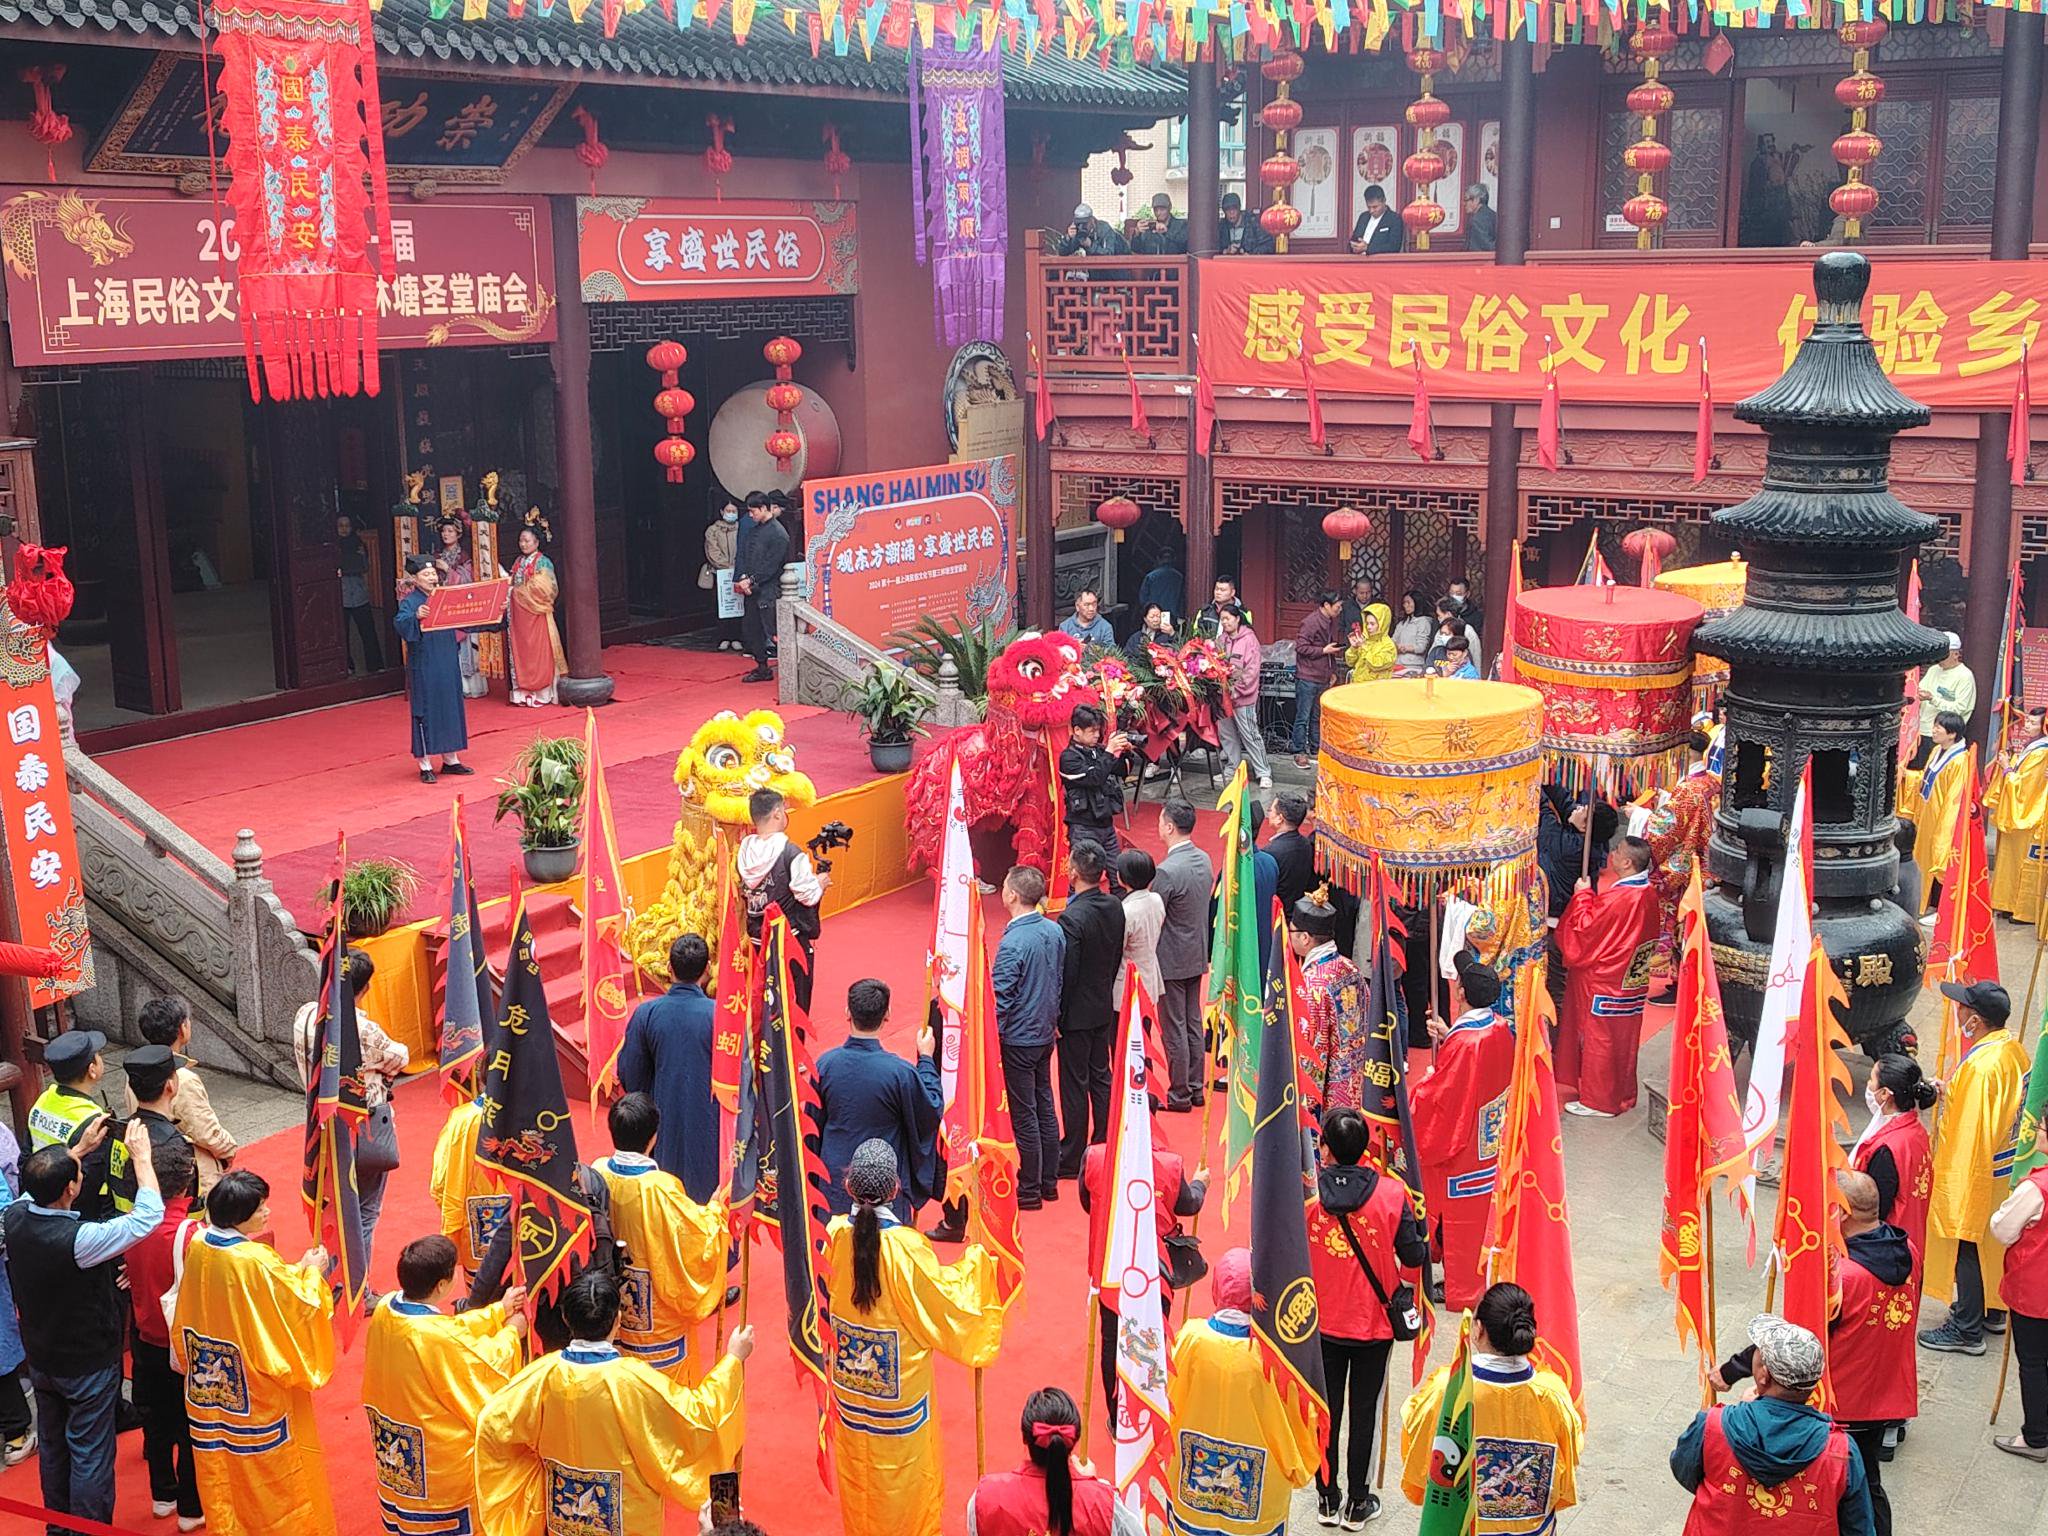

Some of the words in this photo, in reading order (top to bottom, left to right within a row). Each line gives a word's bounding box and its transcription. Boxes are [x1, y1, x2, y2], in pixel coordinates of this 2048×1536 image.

[281, 76, 320, 250] 國泰民安
[643, 226, 802, 274] 享盛世民俗
[1243, 288, 1692, 376] 感受民俗文化
[813, 482, 885, 514] SHANG
[890, 477, 922, 502] HAI
[926, 471, 960, 498] MIN
[7, 704, 63, 890] 国泰民安
[1856, 953, 1894, 988] 殿
